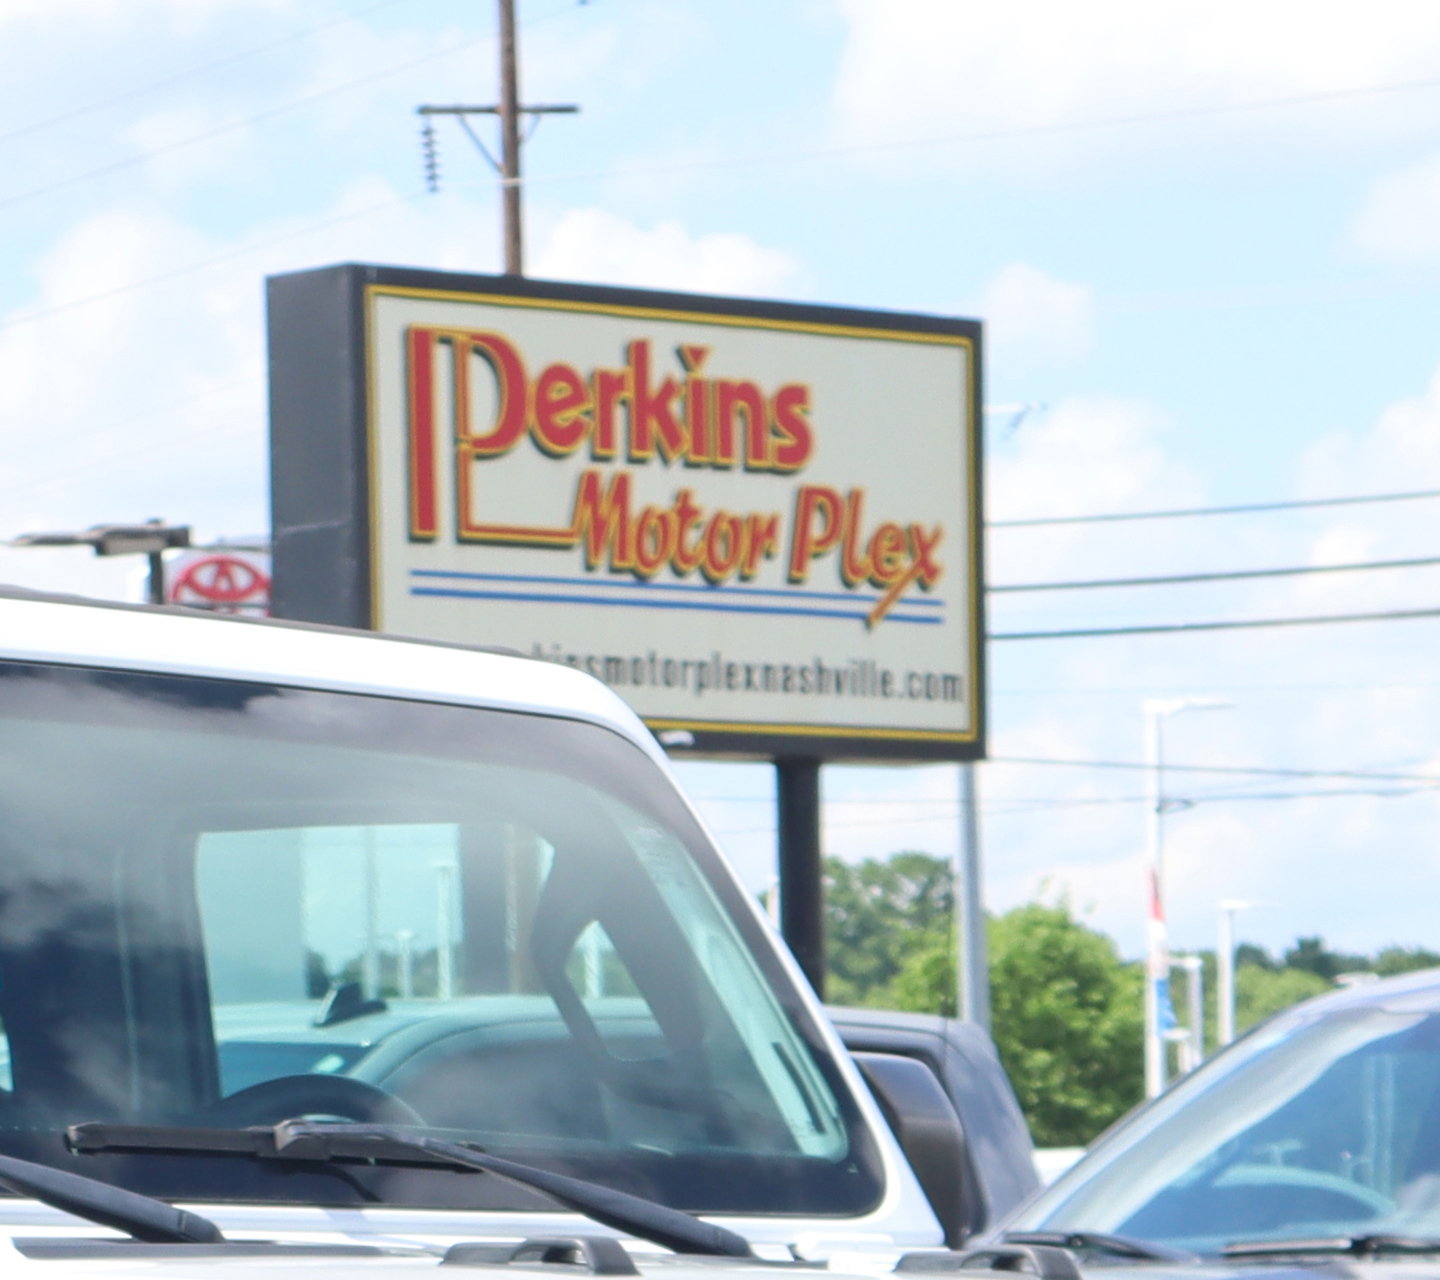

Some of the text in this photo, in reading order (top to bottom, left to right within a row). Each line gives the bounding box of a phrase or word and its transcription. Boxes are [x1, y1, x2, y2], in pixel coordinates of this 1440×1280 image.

[405, 323, 818, 543] Perkins
[572, 466, 946, 626] Motor Plex
